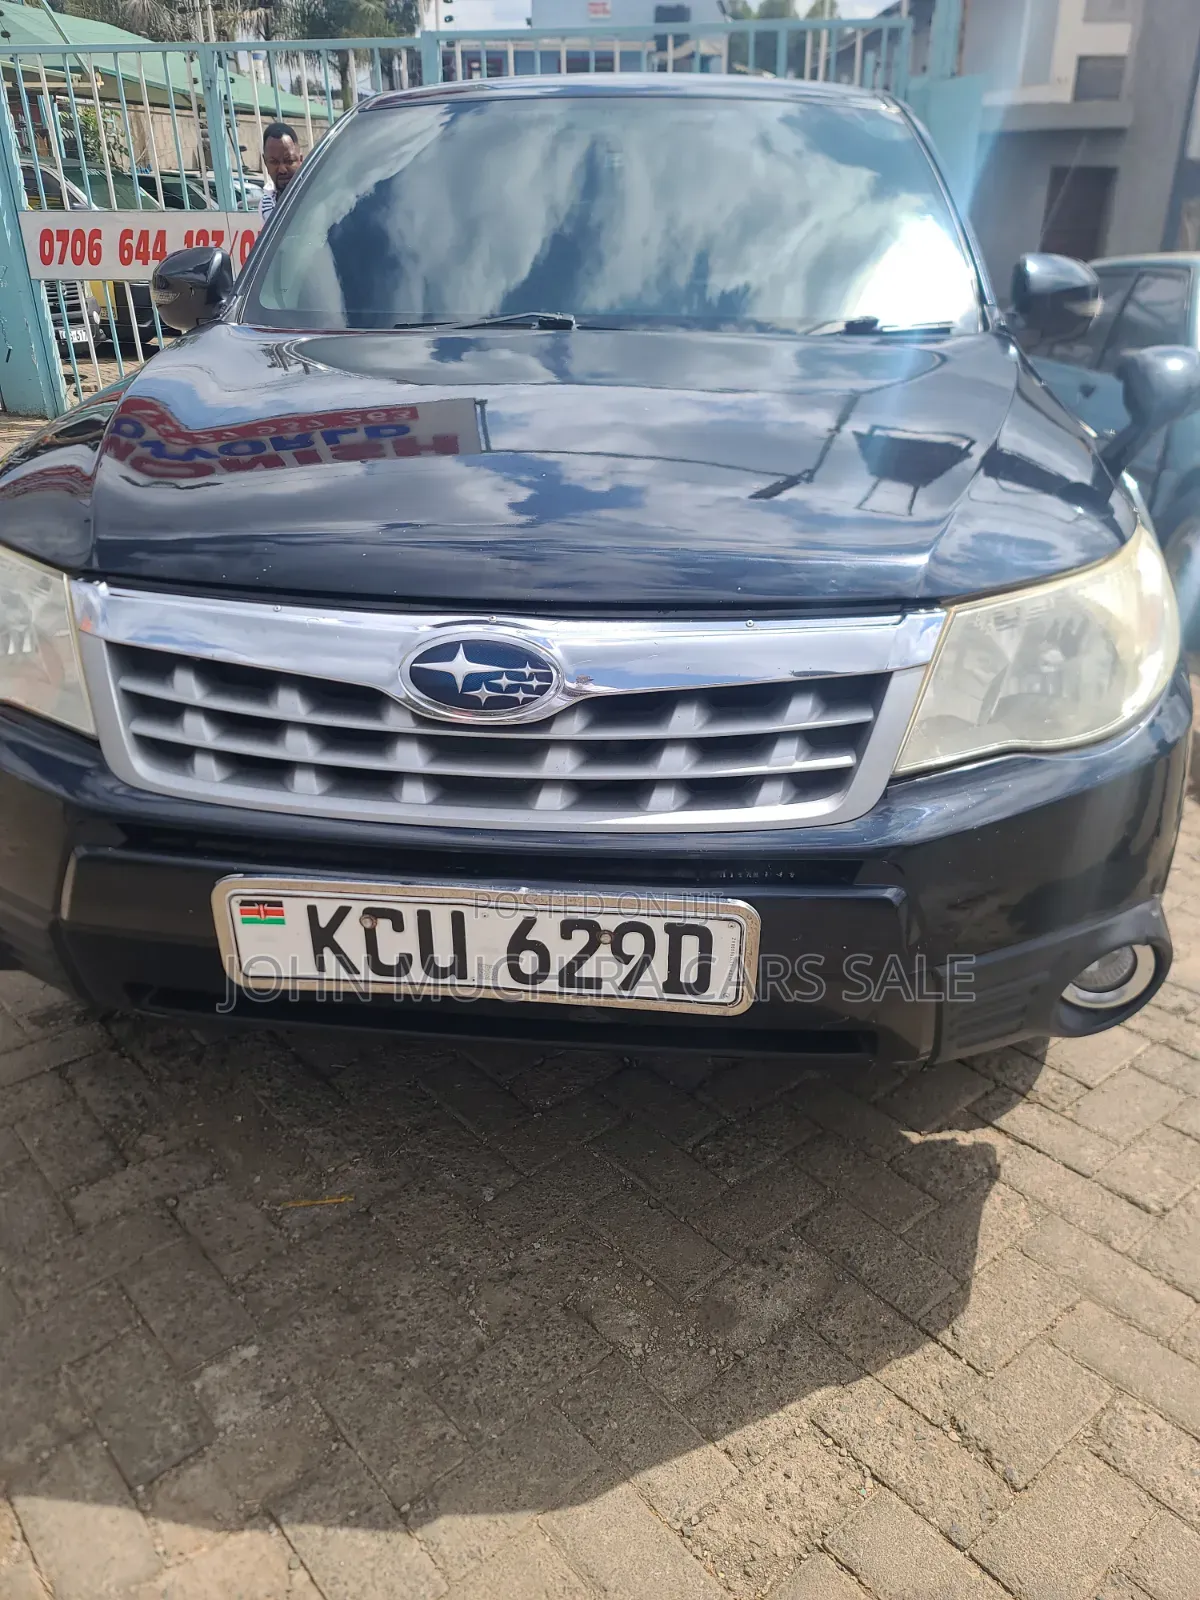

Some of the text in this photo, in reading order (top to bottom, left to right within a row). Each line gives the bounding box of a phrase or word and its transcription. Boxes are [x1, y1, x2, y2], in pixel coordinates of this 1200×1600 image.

[39, 228, 102, 266] 0706
[118, 228, 168, 266] 644
[306, 903, 469, 981] KCU
[506, 915, 714, 996] 629D
